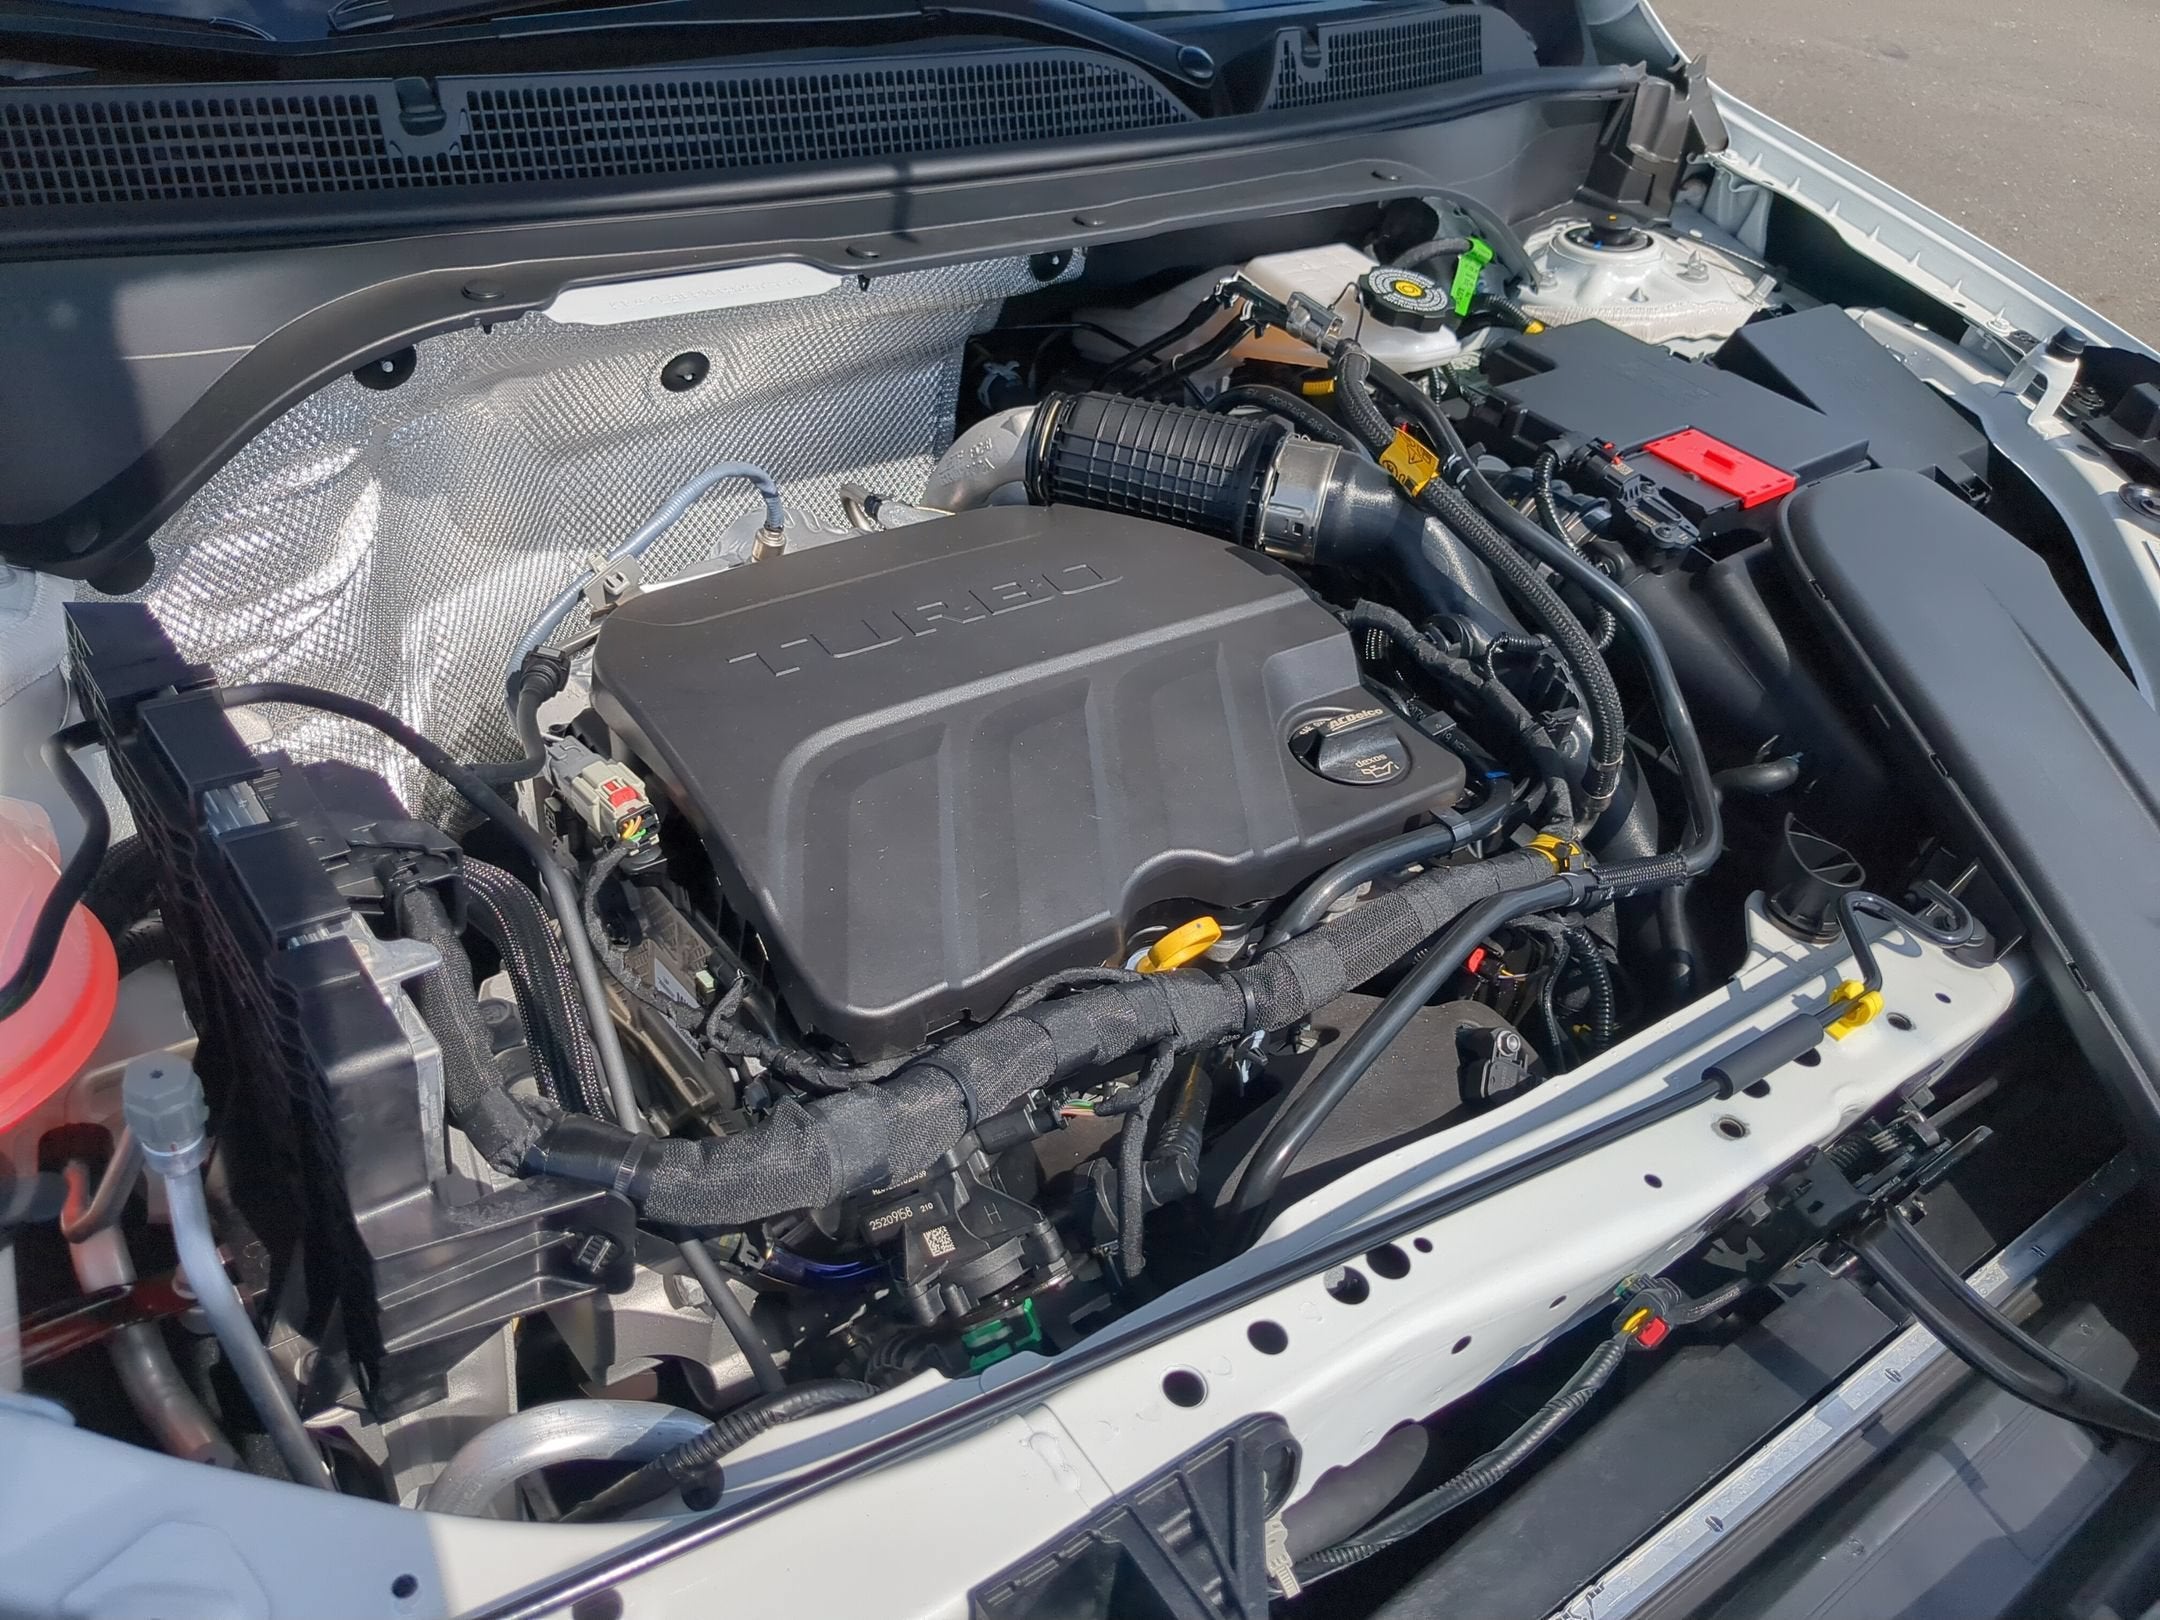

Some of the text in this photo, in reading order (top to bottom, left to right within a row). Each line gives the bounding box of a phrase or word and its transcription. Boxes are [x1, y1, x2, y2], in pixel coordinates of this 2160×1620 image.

[726, 564, 1124, 677] TURBO
[1327, 708, 1384, 730] ACDelco
[1355, 754, 1388, 767] dexos
[869, 1202, 934, 1231] 25209158 210
